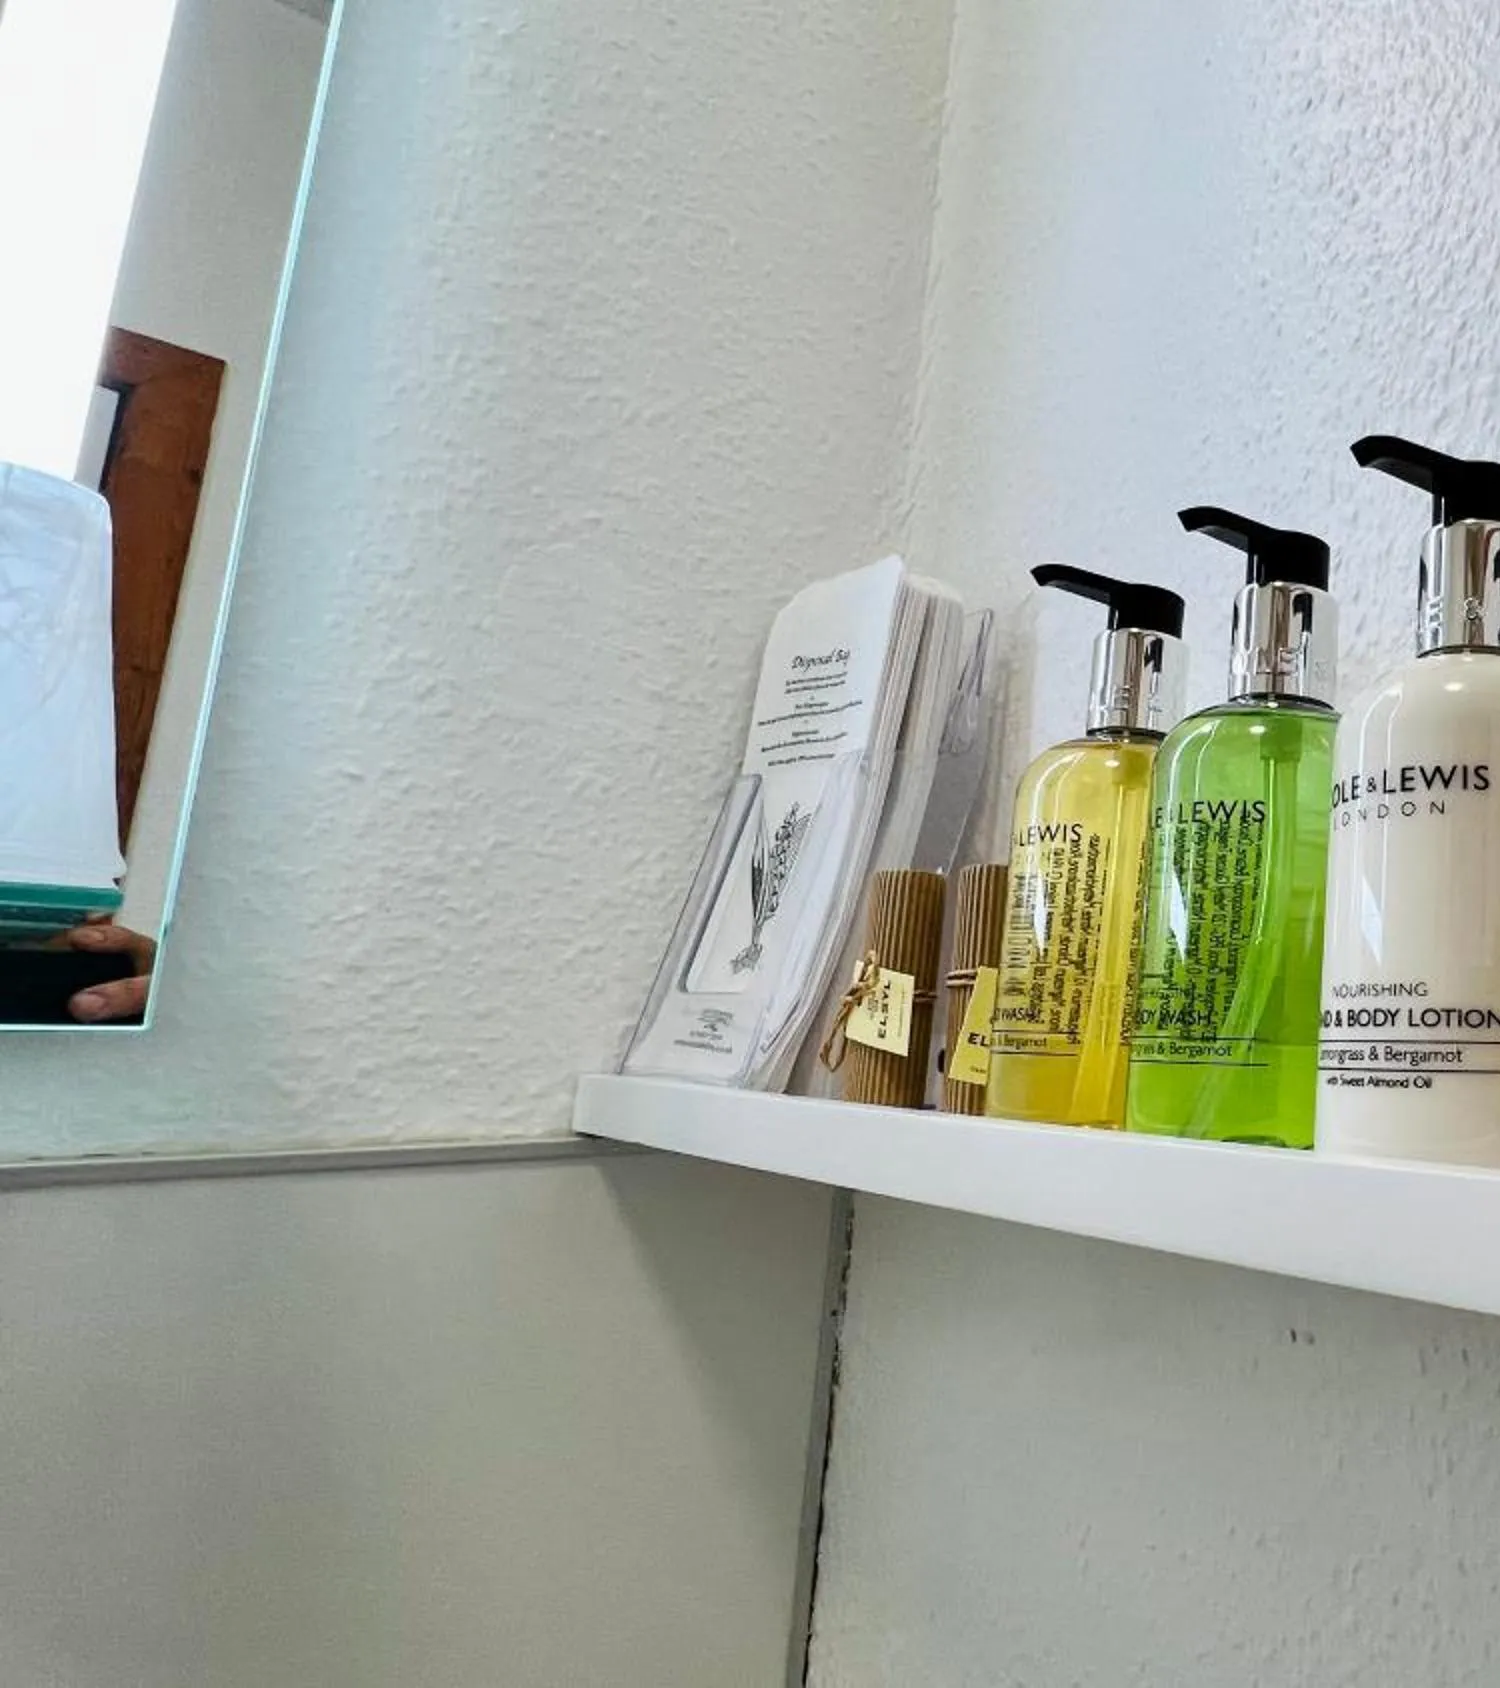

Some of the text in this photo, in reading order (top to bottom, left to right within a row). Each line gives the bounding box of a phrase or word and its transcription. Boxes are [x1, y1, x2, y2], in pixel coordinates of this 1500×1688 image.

[1330, 764, 1491, 811] OLE & LEWIS
[1177, 799, 1266, 825] LEWIS
[1018, 822, 1084, 848] LEWIS
[1331, 981, 1430, 999] NOURISHING
[1333, 1010, 1343, 1029] &
[1347, 1008, 1401, 1028] BODY
[1367, 1045, 1380, 1062] &
[1384, 1045, 1464, 1067] Bergamot
[1366, 1075, 1410, 1089] Almond
[1412, 1075, 1433, 1089] Oil
